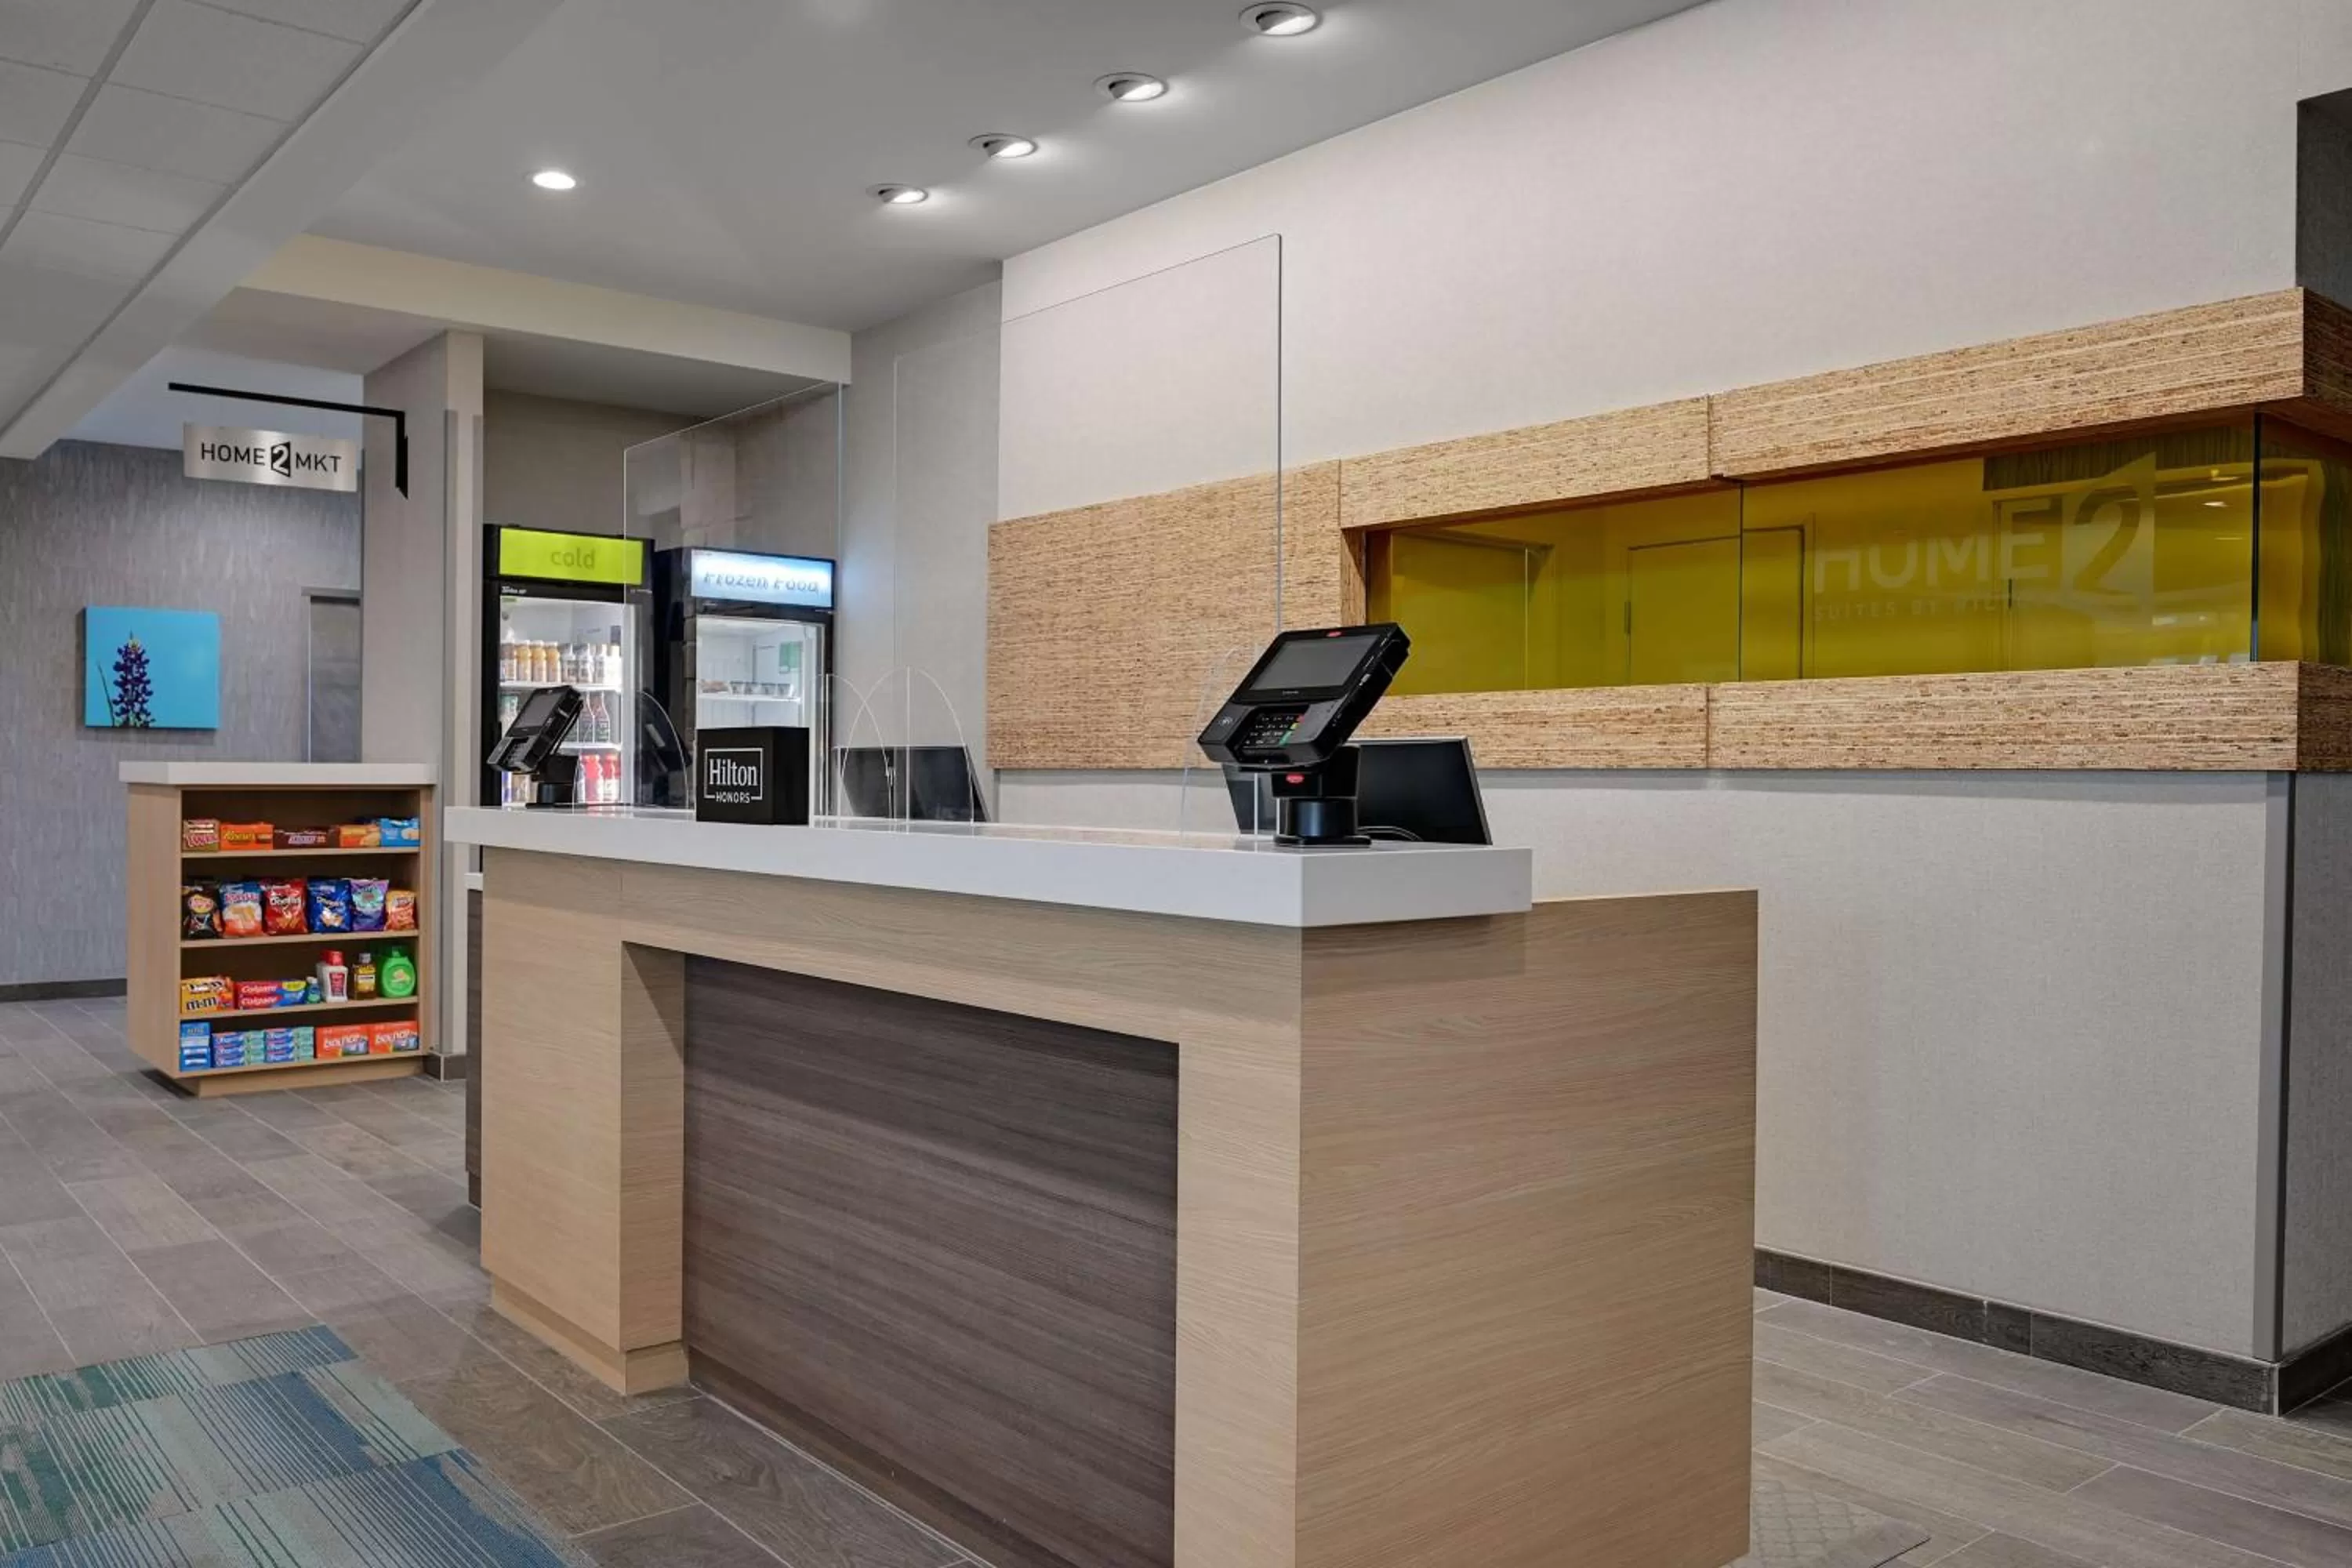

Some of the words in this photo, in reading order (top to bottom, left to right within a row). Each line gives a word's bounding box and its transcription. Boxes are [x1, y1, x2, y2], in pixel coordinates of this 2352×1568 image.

[201, 442, 266, 466] HOME
[296, 452, 342, 473] MKT
[550, 546, 596, 570] cold
[703, 571, 769, 590] Frozen
[773, 576, 819, 594] Food
[709, 758, 758, 786] Hilton
[716, 791, 750, 804] HONORS
